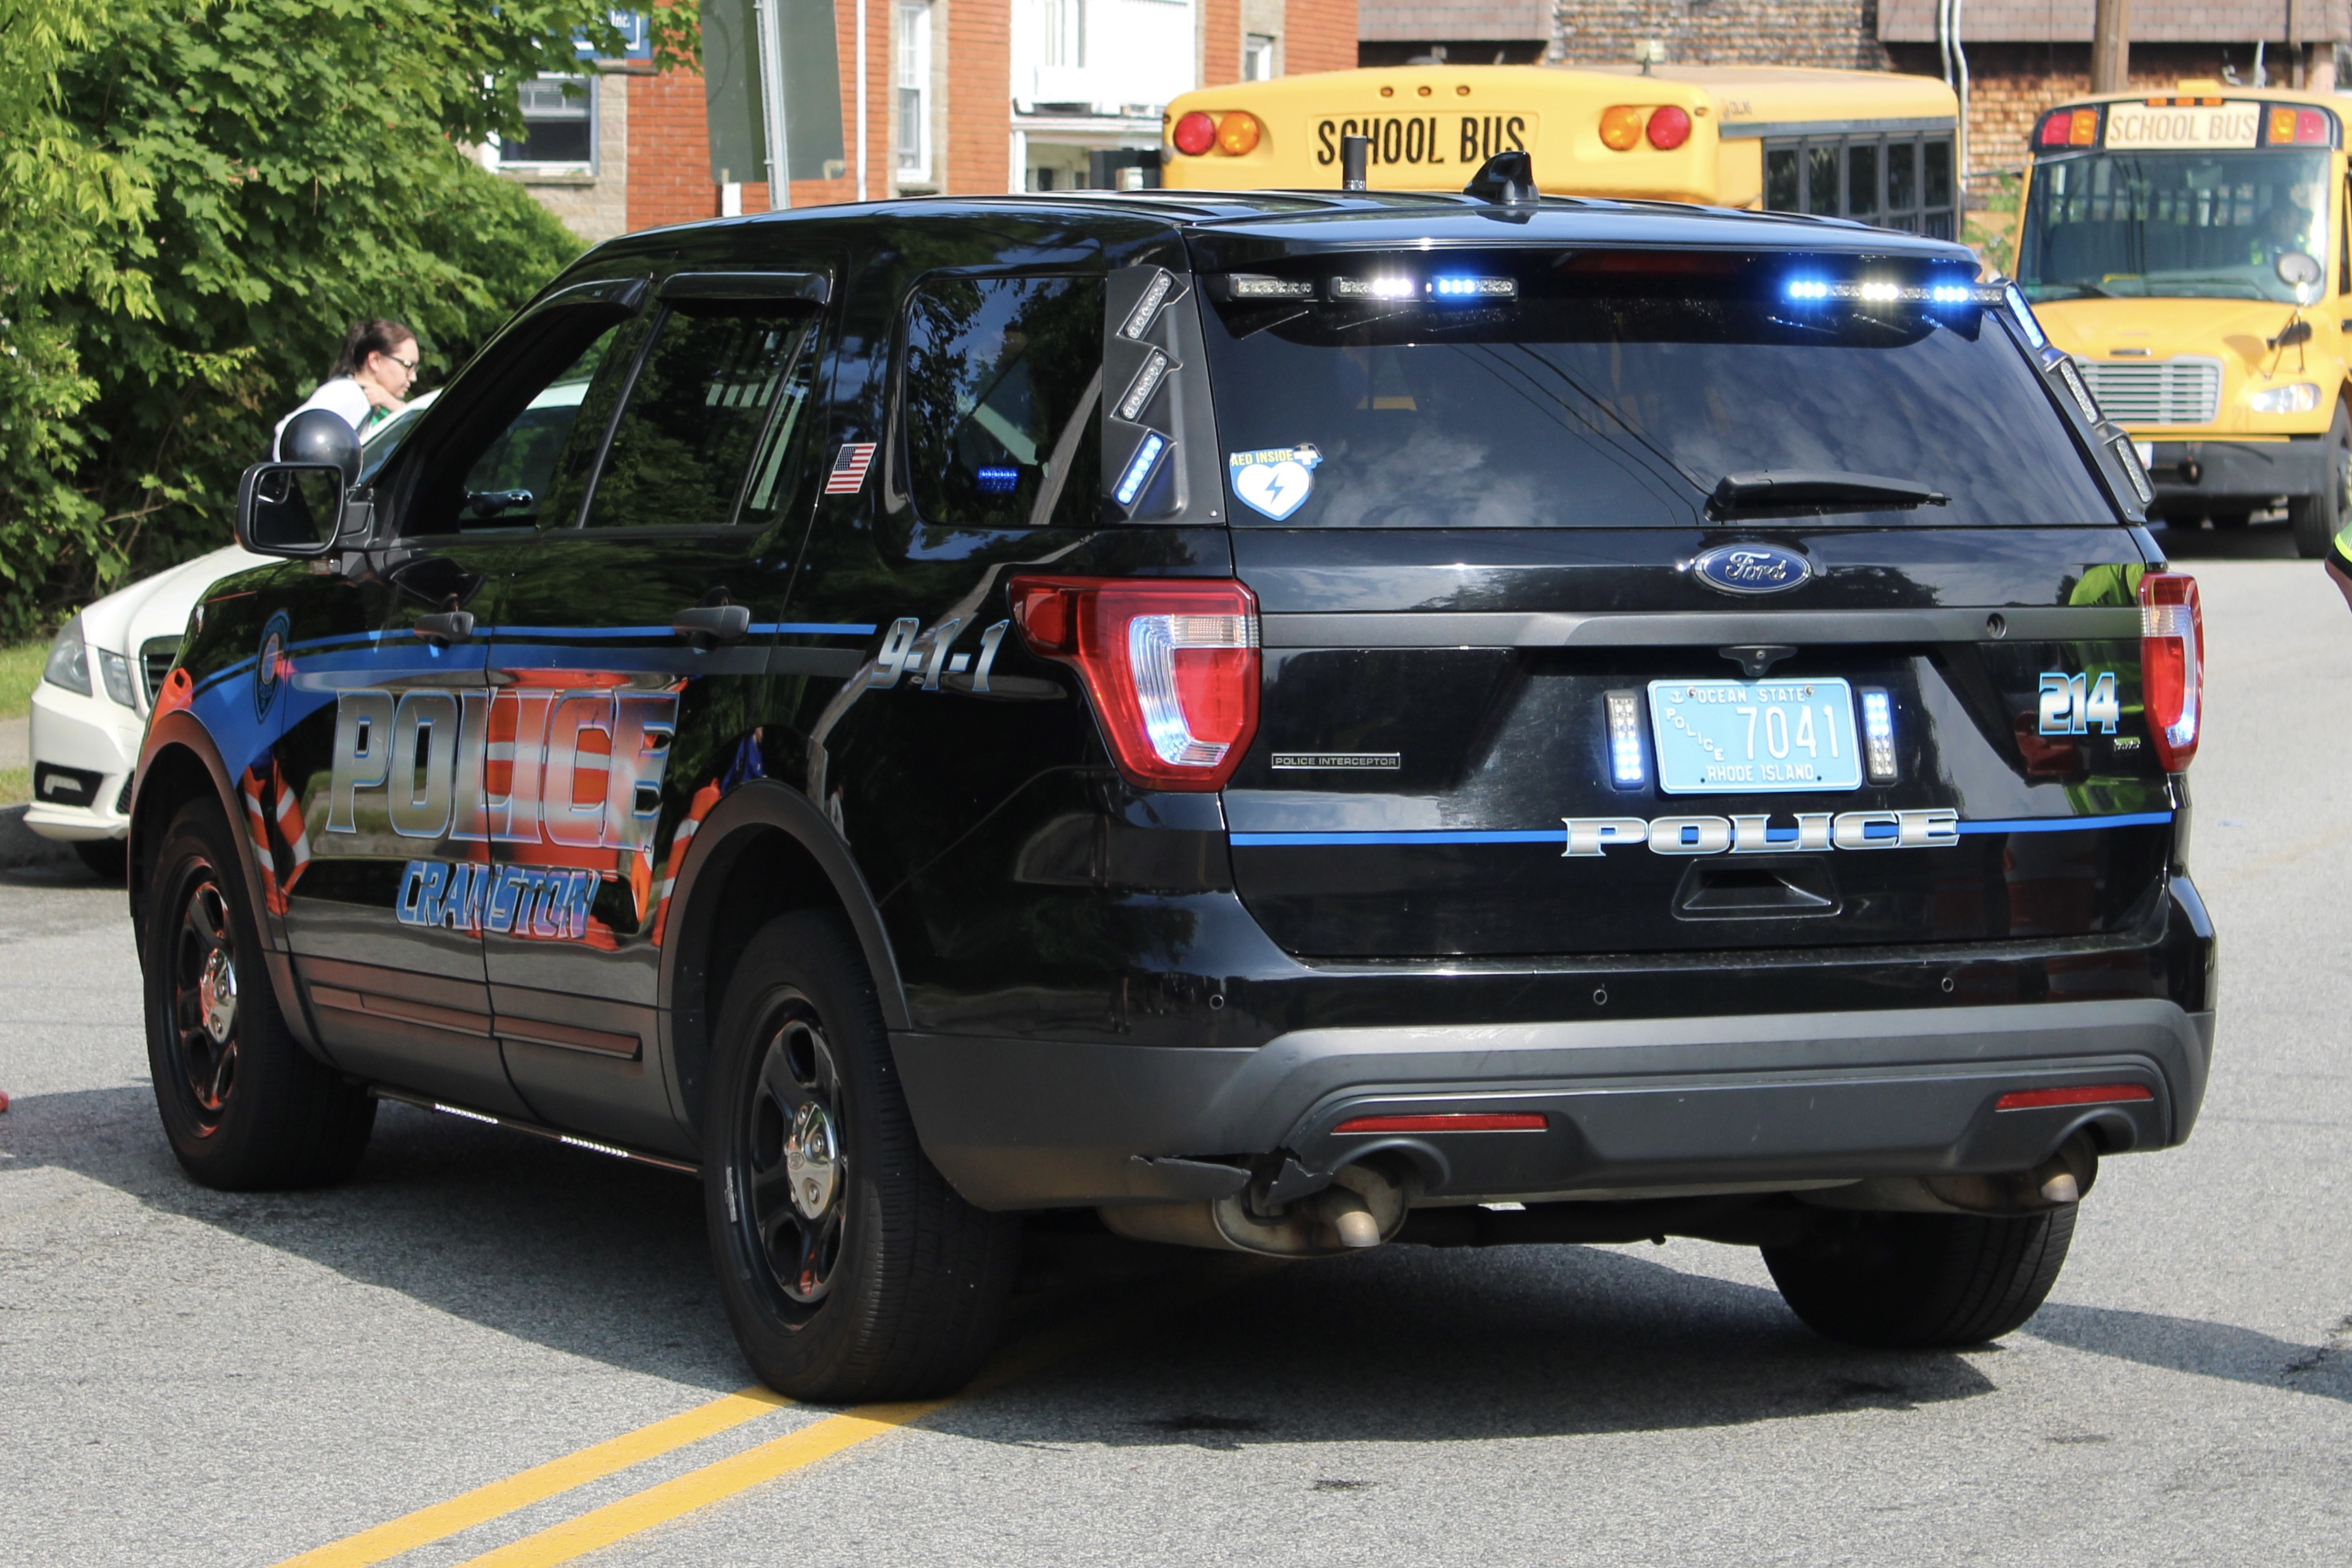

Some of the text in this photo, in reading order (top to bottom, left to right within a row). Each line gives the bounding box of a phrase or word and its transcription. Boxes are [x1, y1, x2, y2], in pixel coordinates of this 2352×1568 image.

[1460, 116, 1526, 163] BUS
[2110, 114, 2257, 142] SCHOOL BUS
[1231, 449, 1294, 467] AED INSIDE
[1725, 551, 1787, 580] Ford
[866, 617, 1010, 692] 9-1-1
[1699, 689, 1806, 703] OCEAN STATE
[2039, 672, 2120, 736] 214
[1666, 708, 1725, 761] POLICE
[1737, 706, 1839, 760] 7041
[325, 686, 681, 853] POLICE
[1275, 757, 1396, 766] POLICE INTERCEPTOR
[1707, 765, 1814, 782] RHODE ISLAND
[1561, 808, 1960, 856] POLICE
[396, 859, 601, 939] CRANSTON
